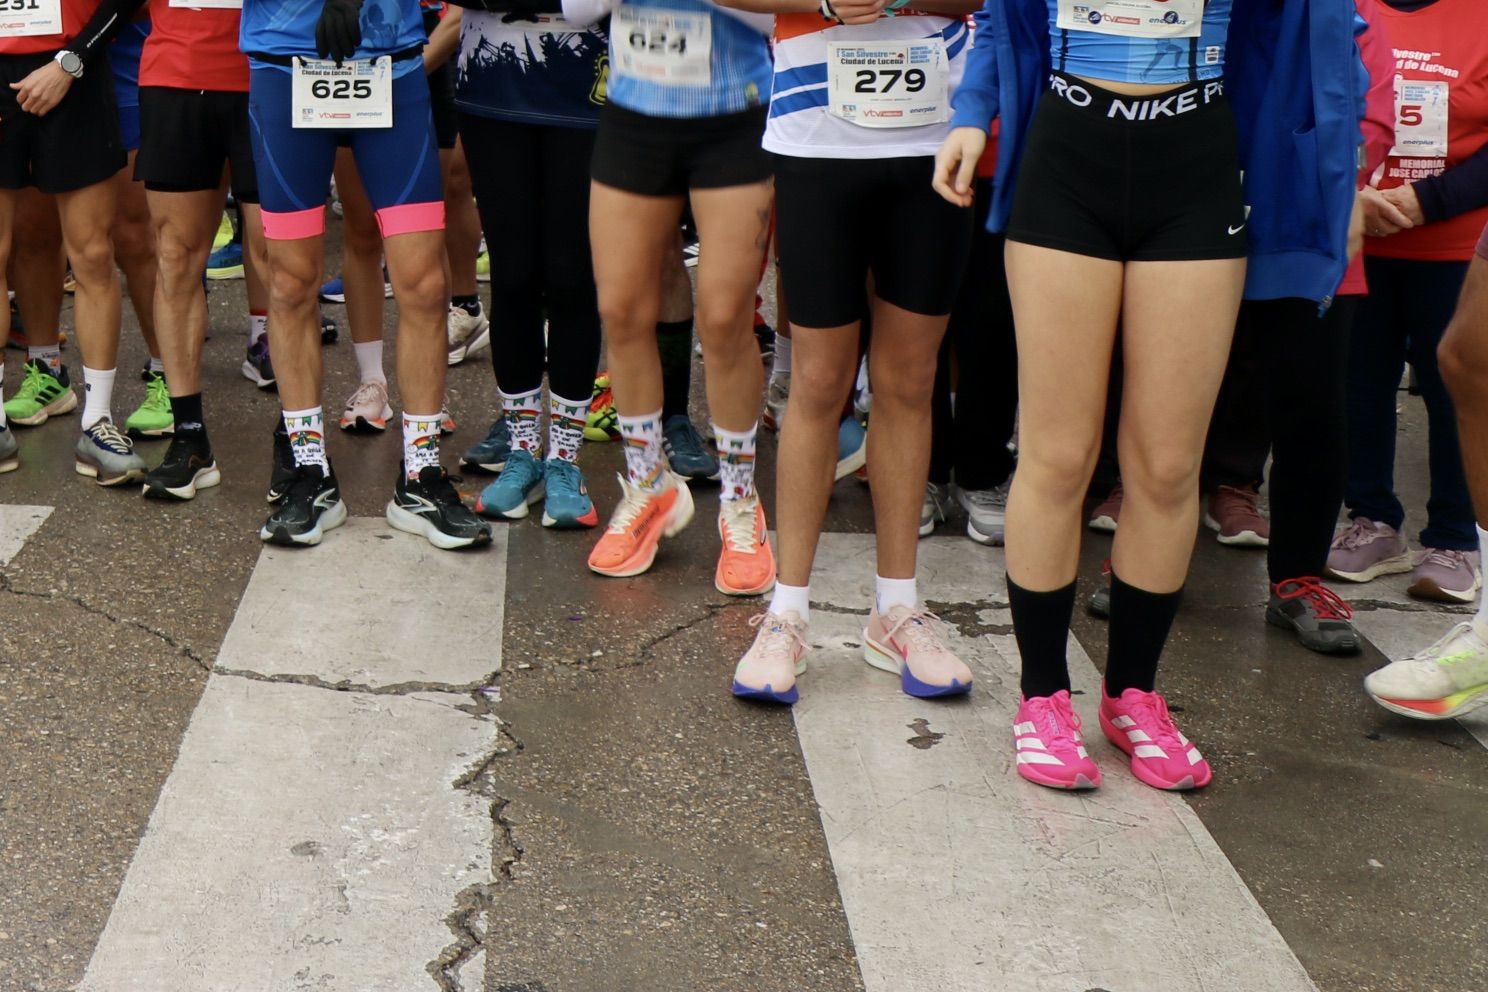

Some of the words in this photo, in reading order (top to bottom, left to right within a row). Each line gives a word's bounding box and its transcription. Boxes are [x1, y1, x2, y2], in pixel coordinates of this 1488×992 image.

[1420, 62, 1459, 78] Lucena
[855, 68, 926, 93] 279
[312, 80, 371, 99] 625
[1049, 75, 1092, 107] RO
[1107, 88, 1198, 120] NIKE
[1400, 159, 1445, 168] MEMORIAL
[1389, 168, 1410, 177] JOSE
